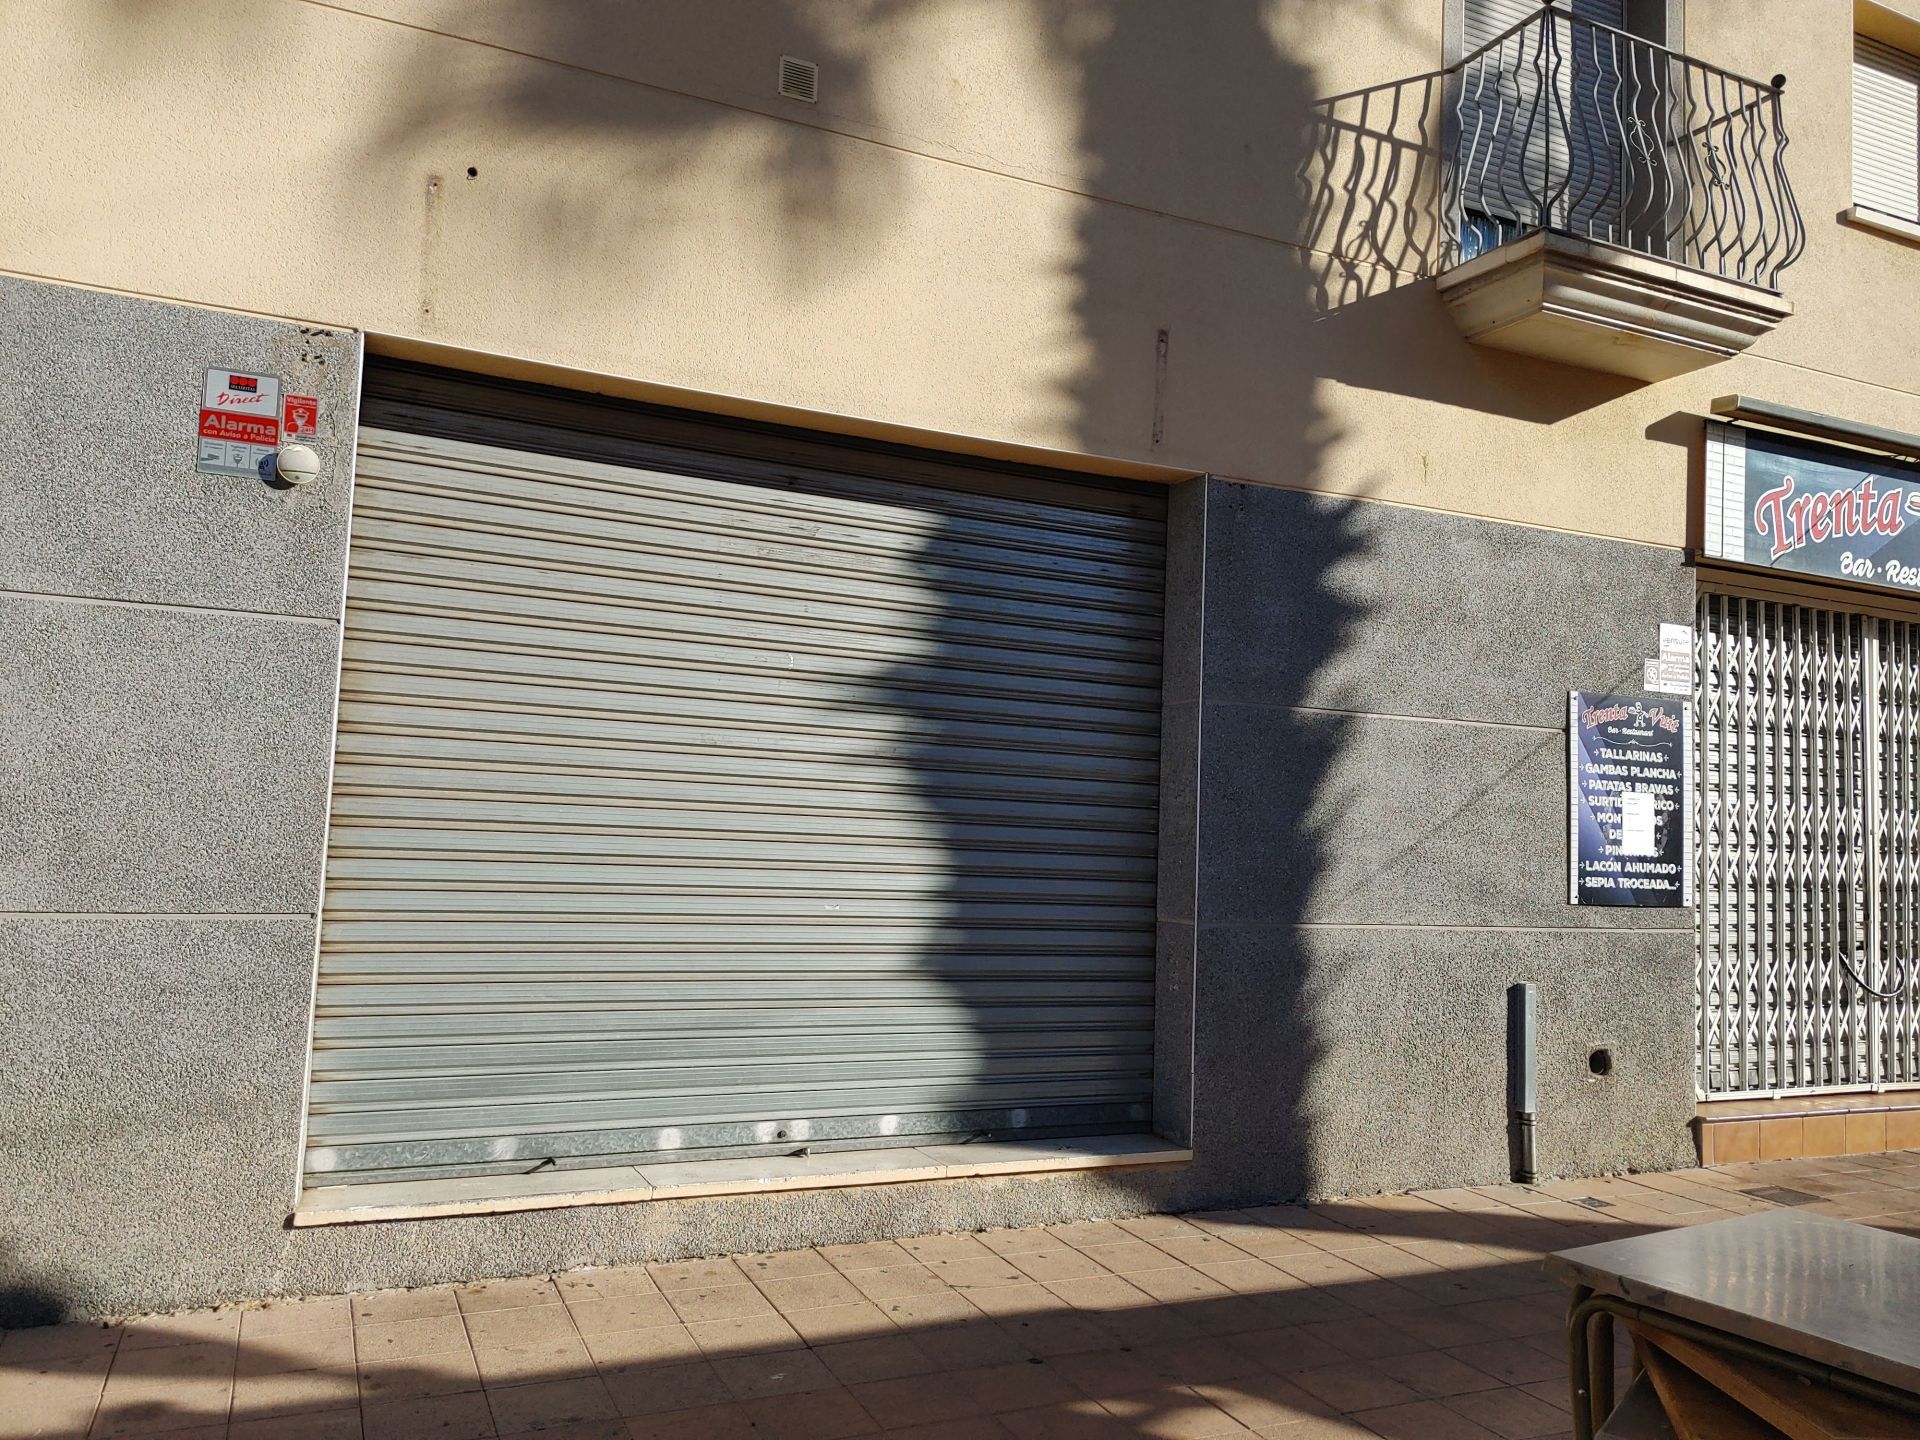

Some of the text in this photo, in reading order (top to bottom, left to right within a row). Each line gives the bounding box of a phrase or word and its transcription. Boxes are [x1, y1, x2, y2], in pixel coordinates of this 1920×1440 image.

[216, 391, 270, 406] Direct
[204, 414, 276, 436] Alarma
[219, 428, 241, 439] Aviso
[1754, 475, 1905, 561] Trenta
[1840, 551, 1875, 578] Bar
[1582, 703, 1680, 733] Trenta Vuit
[1600, 747, 1663, 762] TALLARINAS
[1585, 763, 1677, 779] GAMBAS PLANCHA
[1588, 779, 1674, 795] PATATAS BRAVAS
[1585, 857, 1677, 874] LACÓN AHUMADO
[1585, 877, 1616, 888] SEPIA
